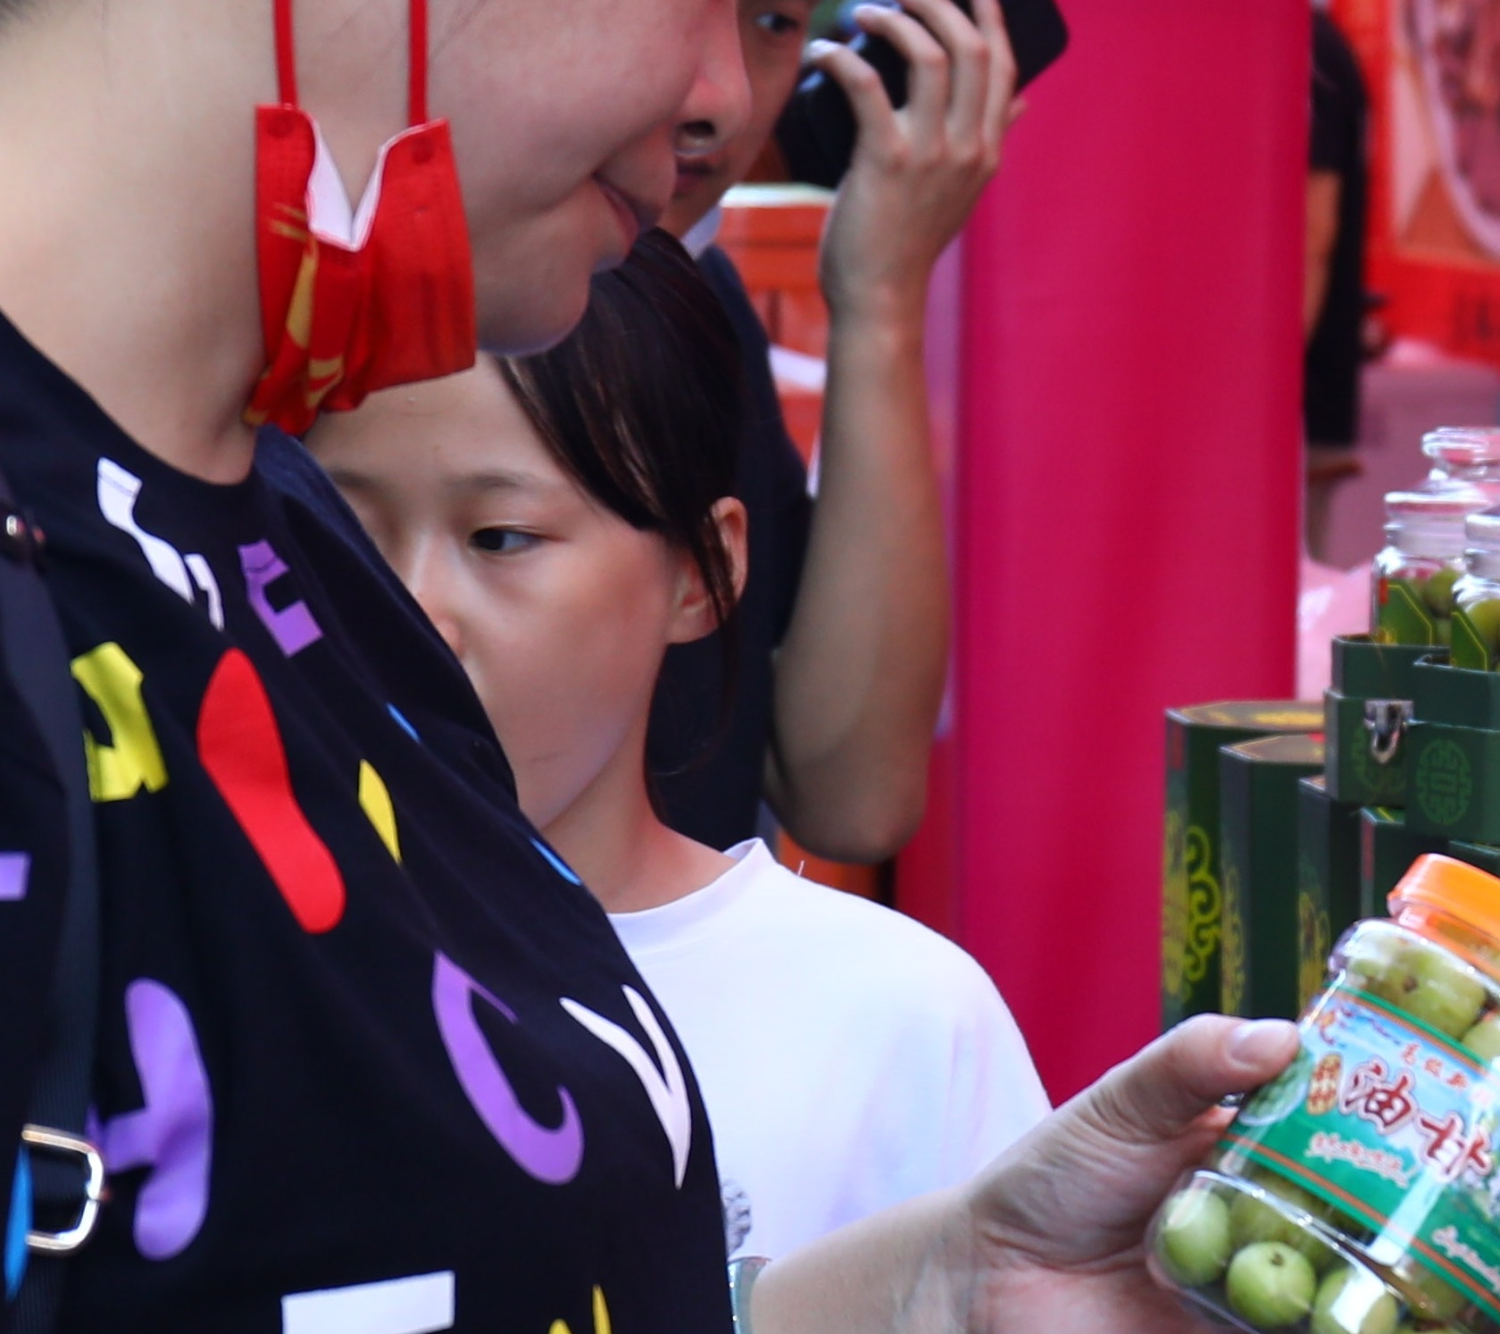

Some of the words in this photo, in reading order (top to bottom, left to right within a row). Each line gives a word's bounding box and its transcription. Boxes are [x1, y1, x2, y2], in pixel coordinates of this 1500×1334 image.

[432, 950, 584, 1186] C
[559, 984, 692, 1190] V
[1339, 1057, 1493, 1183] 油甘
